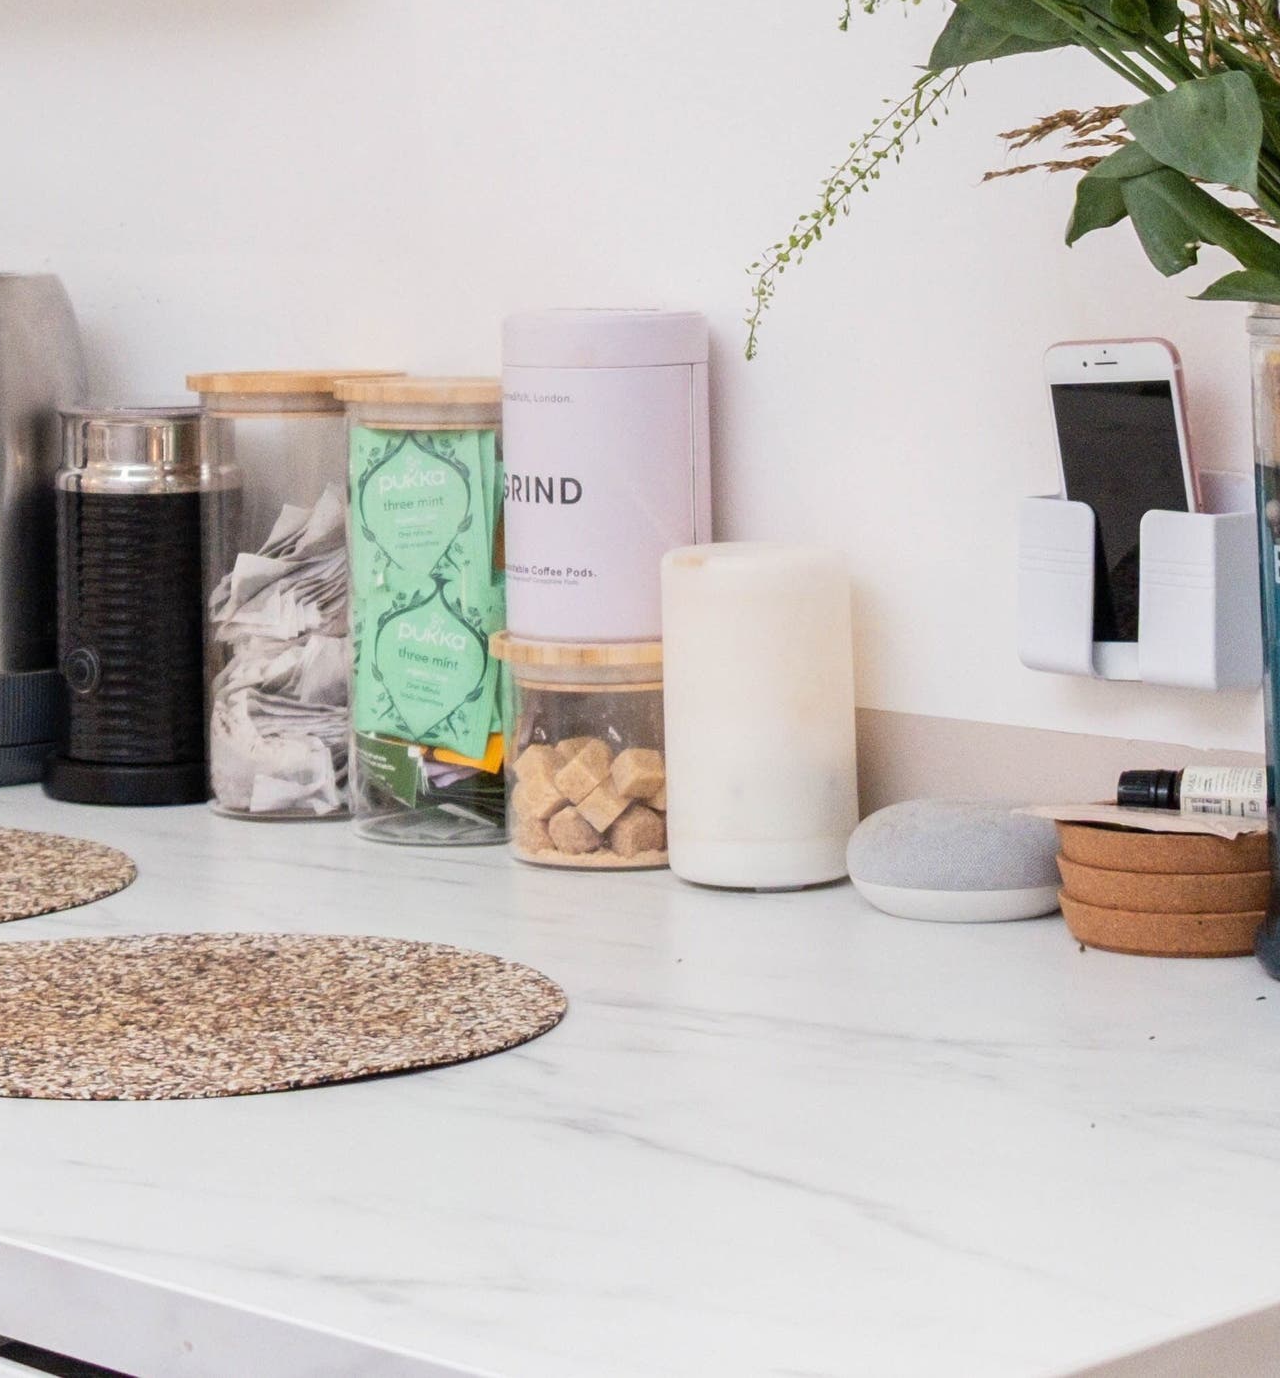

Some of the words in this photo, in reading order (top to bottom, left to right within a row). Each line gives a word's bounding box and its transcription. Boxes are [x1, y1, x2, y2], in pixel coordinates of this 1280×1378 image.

[378, 468, 446, 494] pukka
[383, 498, 414, 512] three
[417, 496, 444, 508] mint
[531, 565, 562, 577] Coffee
[566, 567, 598, 578] Pods.
[398, 621, 467, 652] pukka
[398, 647, 429, 664] three
[432, 656, 459, 671] mint
